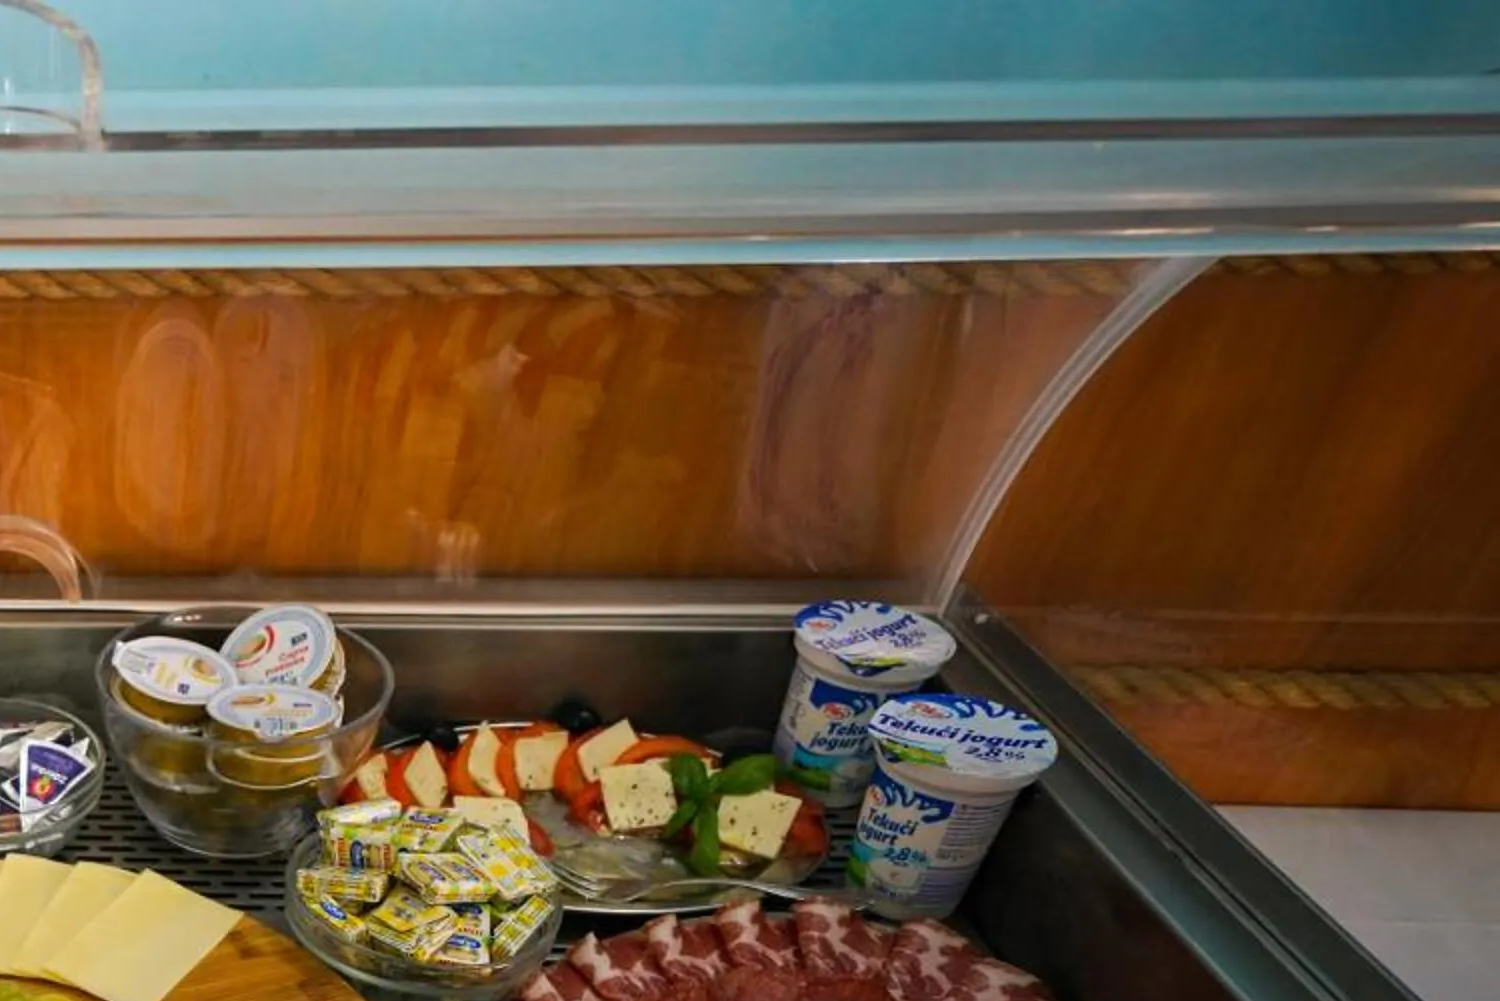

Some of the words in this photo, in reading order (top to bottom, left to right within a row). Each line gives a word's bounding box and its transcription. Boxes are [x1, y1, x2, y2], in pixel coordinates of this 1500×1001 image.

[867, 613, 918, 641] jogurt
[828, 722, 868, 736] Teku
[879, 713, 960, 739] Tekući
[958, 728, 1049, 750] jogurt
